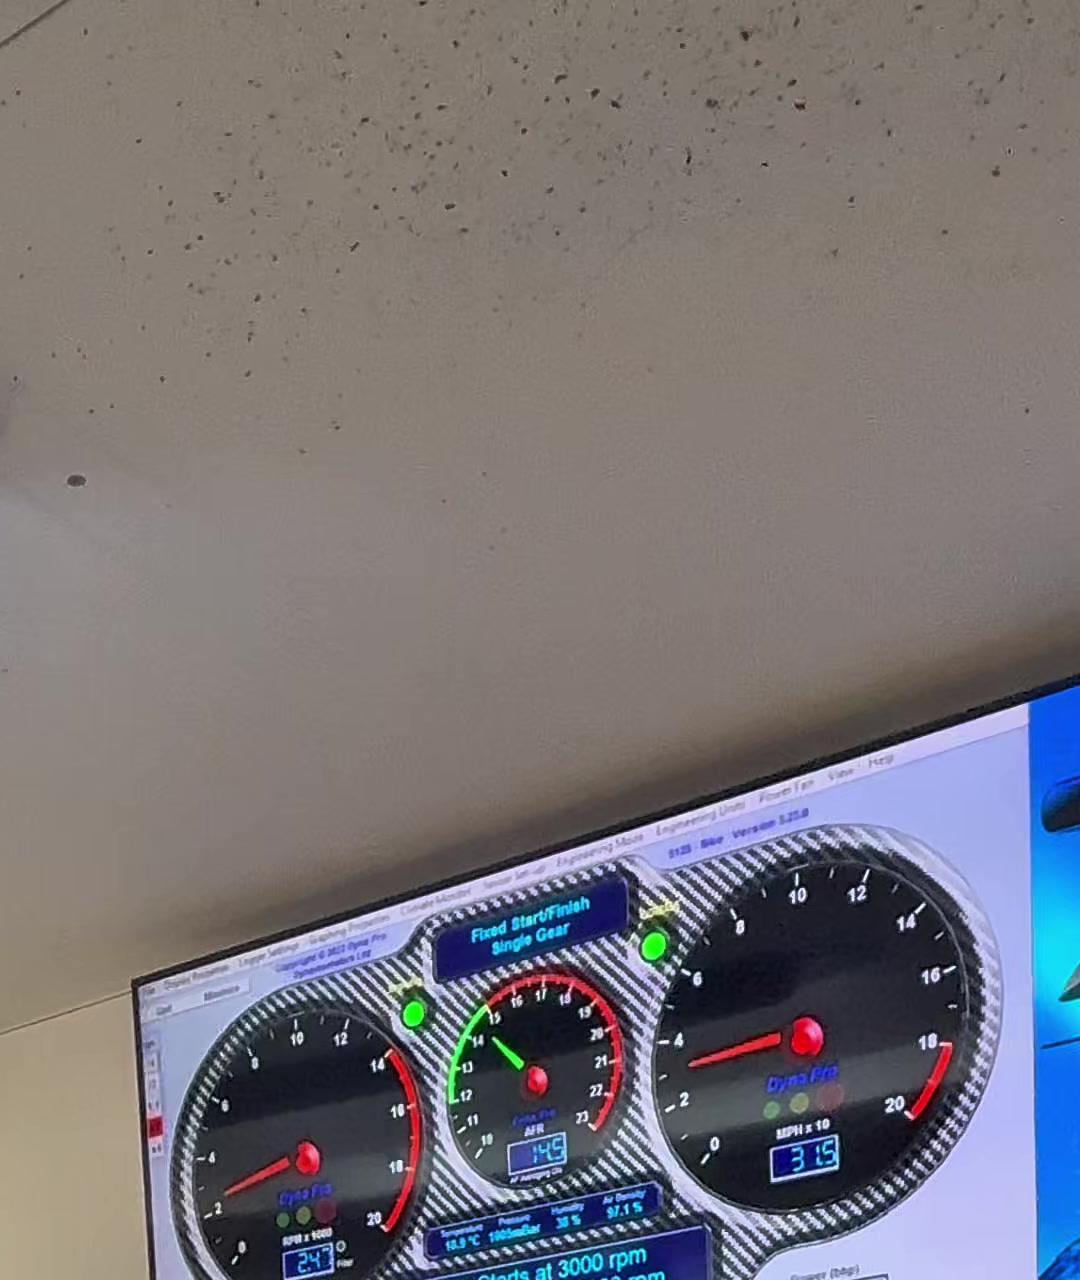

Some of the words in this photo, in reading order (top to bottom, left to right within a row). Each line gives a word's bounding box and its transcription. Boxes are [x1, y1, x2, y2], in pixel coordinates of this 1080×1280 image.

[789, 888, 807, 904] 10
[848, 885, 867, 902] 12
[471, 924, 508, 944] Fixed
[511, 896, 591, 930] Start/Finish
[735, 919, 745, 934] 8
[896, 915, 916, 932] 14
[491, 934, 532, 956] Single
[535, 922, 571, 942] Gear
[693, 971, 703, 987] 6
[921, 967, 941, 984] 16
[535, 988, 547, 1001] 17
[578, 1006, 592, 1019] 19
[290, 1031, 304, 1046] 10
[333, 1031, 349, 1047] 12
[472, 1034, 485, 1047] 14
[590, 1028, 604, 1041] 20
[674, 1032, 684, 1047] 4
[919, 1034, 938, 1050] 18
[252, 1057, 260, 1070] 8
[370, 1056, 386, 1072] 14
[594, 1055, 608, 1069] 21
[767, 1072, 807, 1093] Dyna
[810, 1063, 839, 1082] Pro
[460, 1090, 473, 1101] 12
[589, 1084, 603, 1097] 22
[221, 1099, 230, 1112] 6
[680, 1093, 689, 1107] 2
[884, 1096, 905, 1112] 20
[390, 1104, 405, 1118] 16
[576, 1110, 590, 1124] 23
[467, 1114, 479, 1126] 11
[776, 1124, 803, 1140] MPH
[805, 1124, 812, 1134] x
[816, 1118, 830, 1132] 10
[709, 1136, 720, 1151] 0
[388, 1160, 403, 1174] 18
[215, 1202, 222, 1214] 2
[366, 1211, 382, 1226] 20
[238, 1240, 247, 1253] 0
[558, 1254, 604, 1277] 3000
[608, 1248, 648, 1272] rpm
